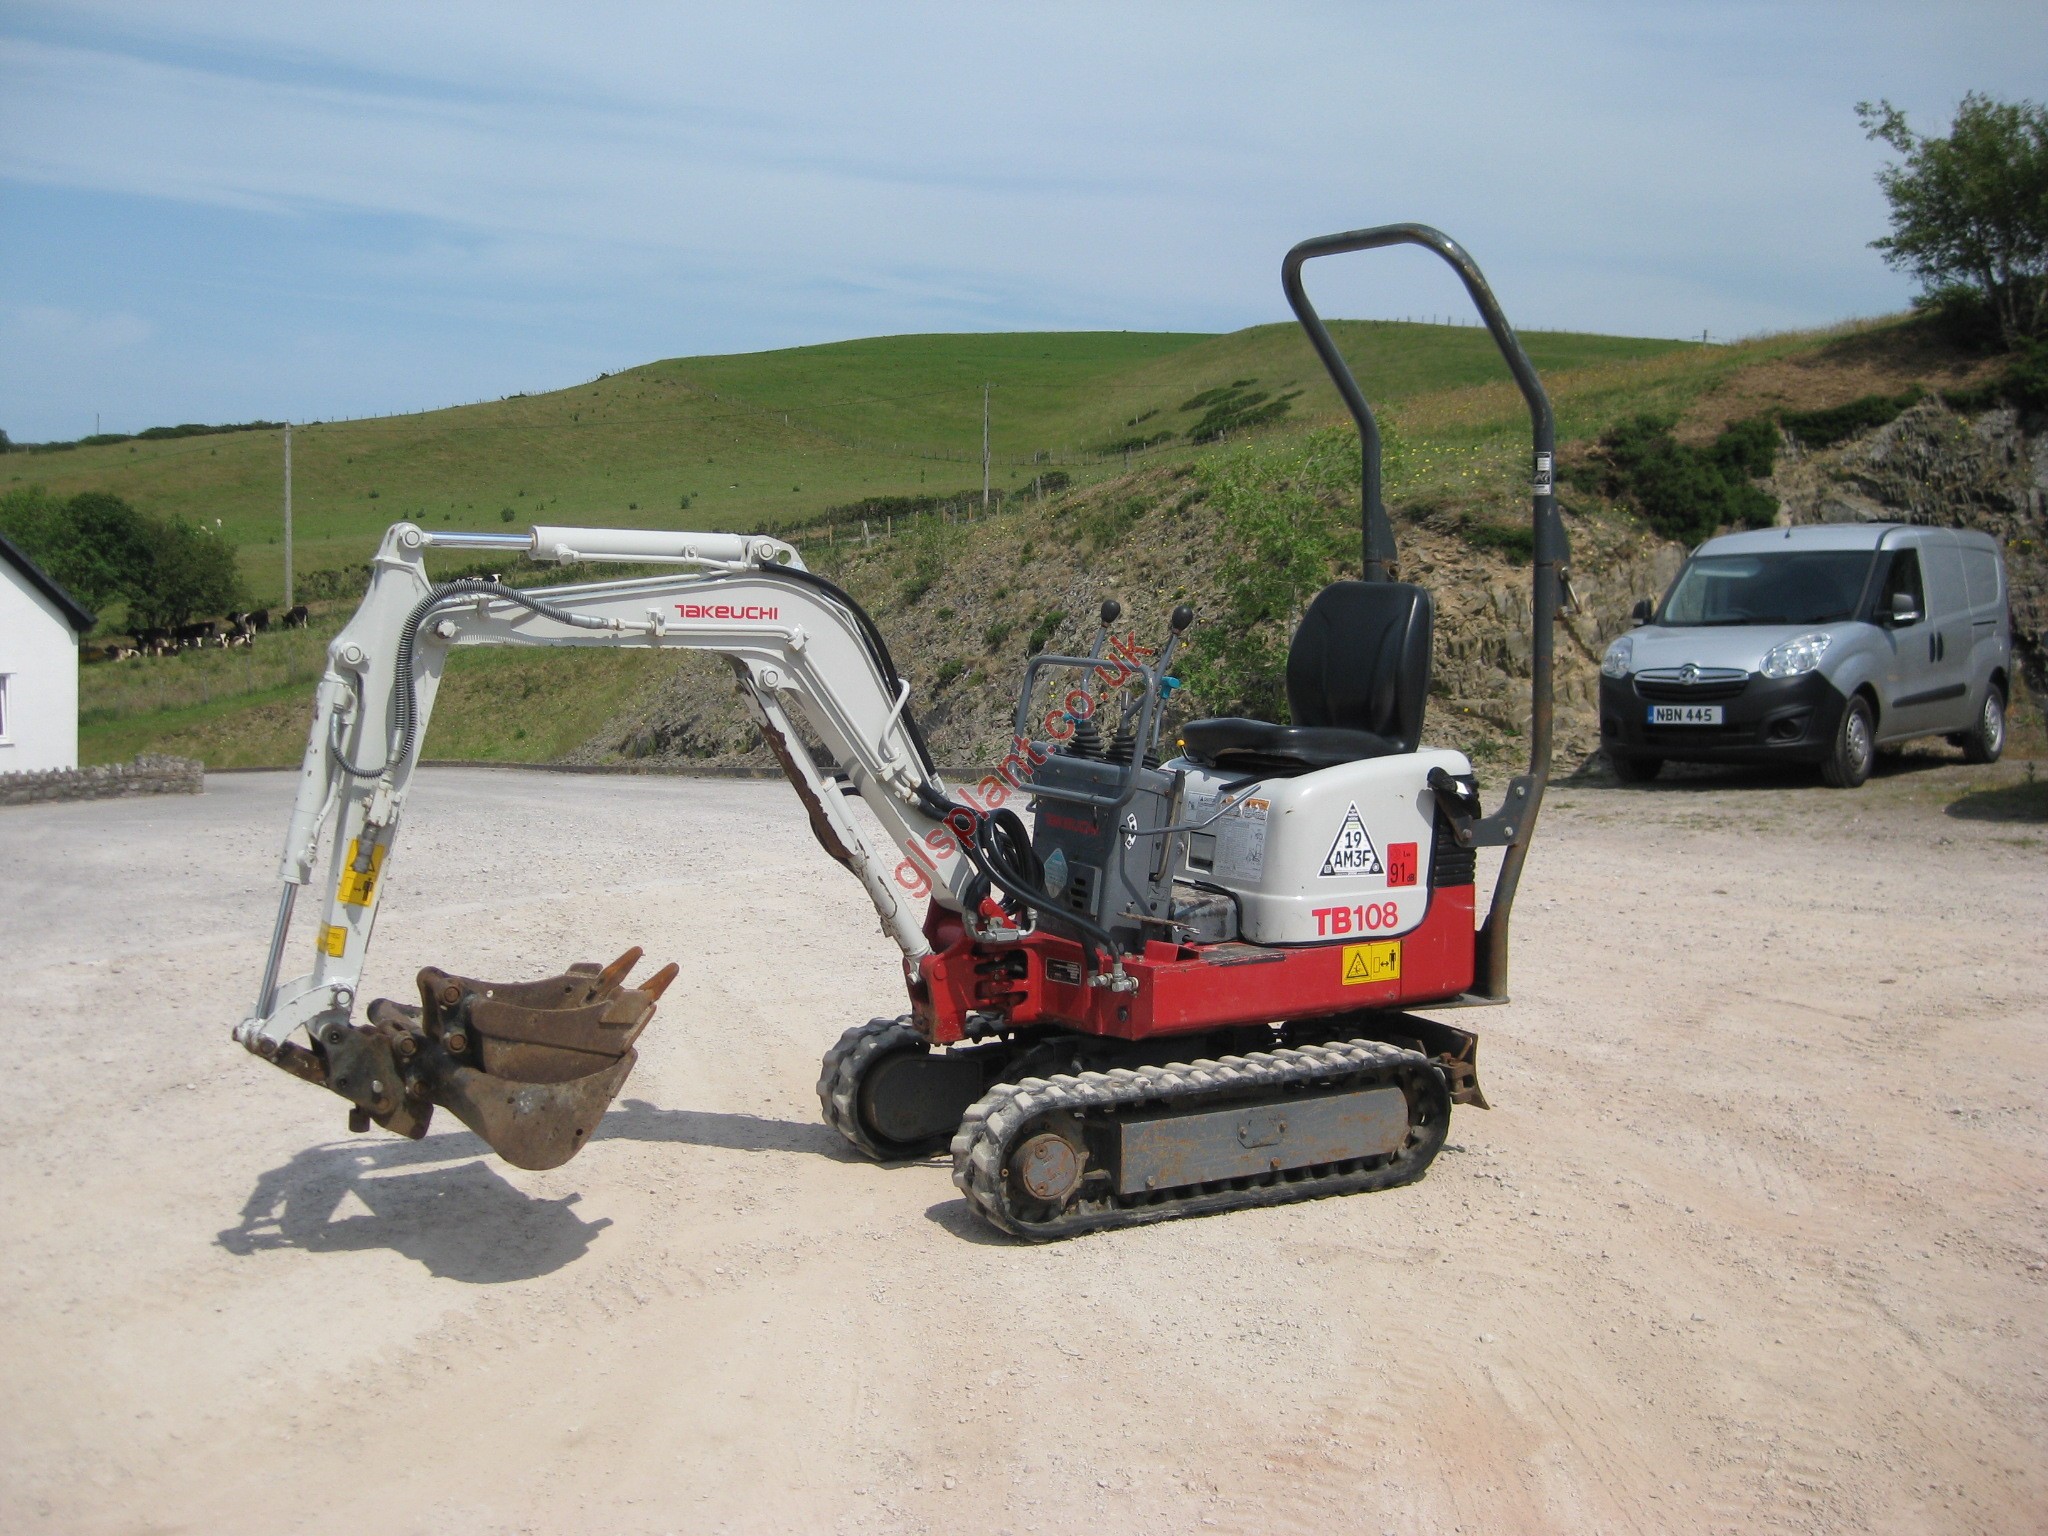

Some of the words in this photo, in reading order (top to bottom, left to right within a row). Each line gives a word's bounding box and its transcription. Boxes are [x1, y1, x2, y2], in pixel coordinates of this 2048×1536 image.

[674, 604, 778, 620] TAKEUCHI
[1656, 708, 1682, 721] NBN
[1687, 708, 1712, 721] 445
[1345, 831, 1362, 849] 19
[1334, 850, 1371, 868] AM3F
[1390, 862, 1406, 883] 91
[1311, 901, 1398, 936] TB108
